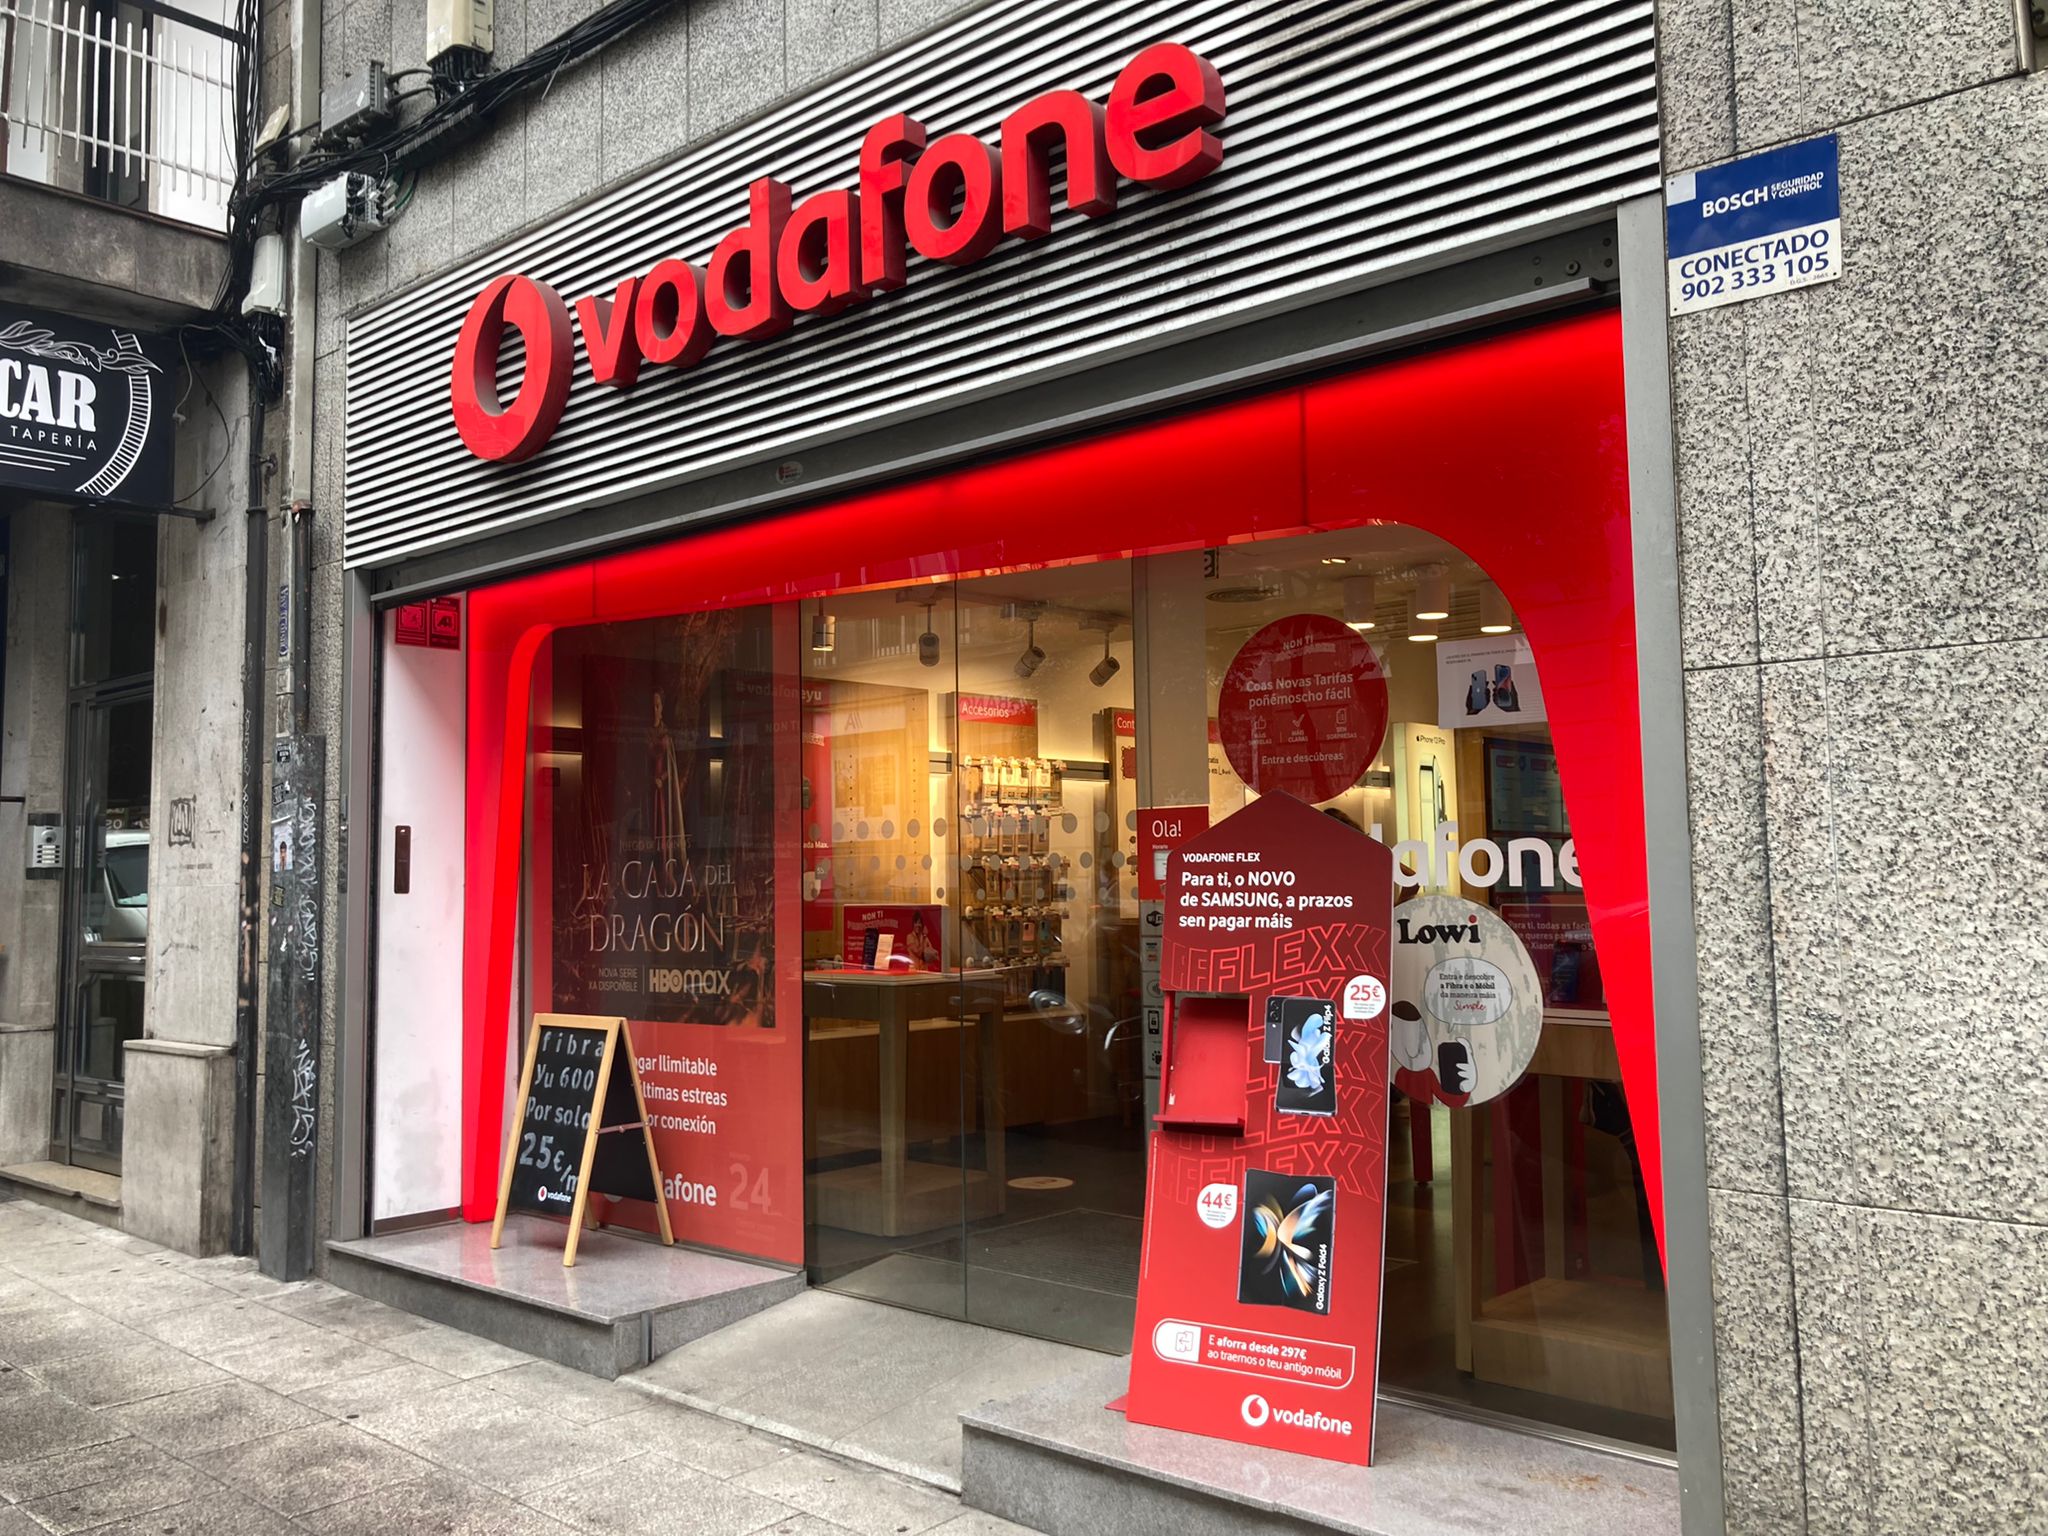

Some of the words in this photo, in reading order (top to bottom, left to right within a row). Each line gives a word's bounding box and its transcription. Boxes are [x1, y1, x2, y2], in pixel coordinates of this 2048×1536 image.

[1770, 171, 1824, 191] SEGURIDAD
[1771, 191, 1777, 200] Y
[1778, 181, 1822, 198] CONTROL
[1702, 185, 1769, 218] BOSCH
[575, 42, 1225, 387] vodafone
[1680, 229, 1830, 279] CONECTADO
[1682, 276, 1725, 302] 902
[1730, 264, 1776, 290] 333
[1783, 251, 1829, 277] 105
[10, 425, 97, 451] TAPERÍA
[1246, 680, 1273, 692] Coas
[1276, 677, 1311, 689] Novas
[1314, 672, 1353, 686] Tarifas
[961, 702, 1009, 719] Accesorios
[1249, 691, 1323, 710] poñémoscho
[1325, 687, 1351, 700] fácil
[1262, 754, 1285, 765] Entra
[1293, 751, 1344, 763] descúbreas
[1152, 820, 1182, 838] Ola!
[1182, 852, 1235, 863] VODAFONE
[1236, 852, 1261, 863] FLEX
[582, 863, 614, 900] LA
[622, 858, 698, 899] CASA
[705, 864, 735, 886] DEL
[1181, 871, 1214, 887] Para
[1217, 871, 1232, 888] ti,
[1234, 875, 1245, 887] o
[1248, 871, 1296, 887] NOVO
[1180, 892, 1198, 907] de
[1201, 891, 1283, 909] SAMSUNG,
[1286, 895, 1295, 907] a
[1298, 895, 1353, 911] prazos
[589, 904, 727, 953] DRAGÓN
[1179, 915, 1206, 928] sen
[1208, 915, 1252, 931] pagar
[1255, 912, 1293, 929] máis
[1397, 914, 1481, 944] Lowi
[598, 968, 618, 978] NOVA
[620, 968, 638, 979] SERIE
[1350, 984, 1381, 1001] 25€
[1323, 1005, 1334, 1025] Flip4
[1455, 1000, 1486, 1012] Simple
[542, 1031, 604, 1057] fibra
[1322, 1033, 1333, 1064] Galaxy
[659, 1054, 718, 1076] Ilimitable
[560, 1067, 595, 1092] 600
[640, 1081, 679, 1102] ltimas
[681, 1087, 728, 1107] estreas
[526, 1095, 552, 1121] Por
[554, 1106, 591, 1130] solo
[660, 1114, 717, 1135] conexión
[547, 1191, 572, 1203] vodafone
[660, 1171, 718, 1207] afone
[1201, 1191, 1232, 1209] 44€
[1318, 1243, 1327, 1269] Fold4
[1316, 1275, 1327, 1310] Galaxy
[1208, 1334, 1215, 1346] E
[1217, 1335, 1248, 1351] aforra
[1249, 1341, 1279, 1355] desde
[1281, 1346, 1307, 1360] 297€
[1207, 1350, 1219, 1360] ao
[1258, 1358, 1265, 1367] o
[1267, 1358, 1282, 1370] teu
[1283, 1361, 1313, 1376] antigo
[1314, 1366, 1342, 1380] móbil
[1272, 1407, 1353, 1436] vodafone
